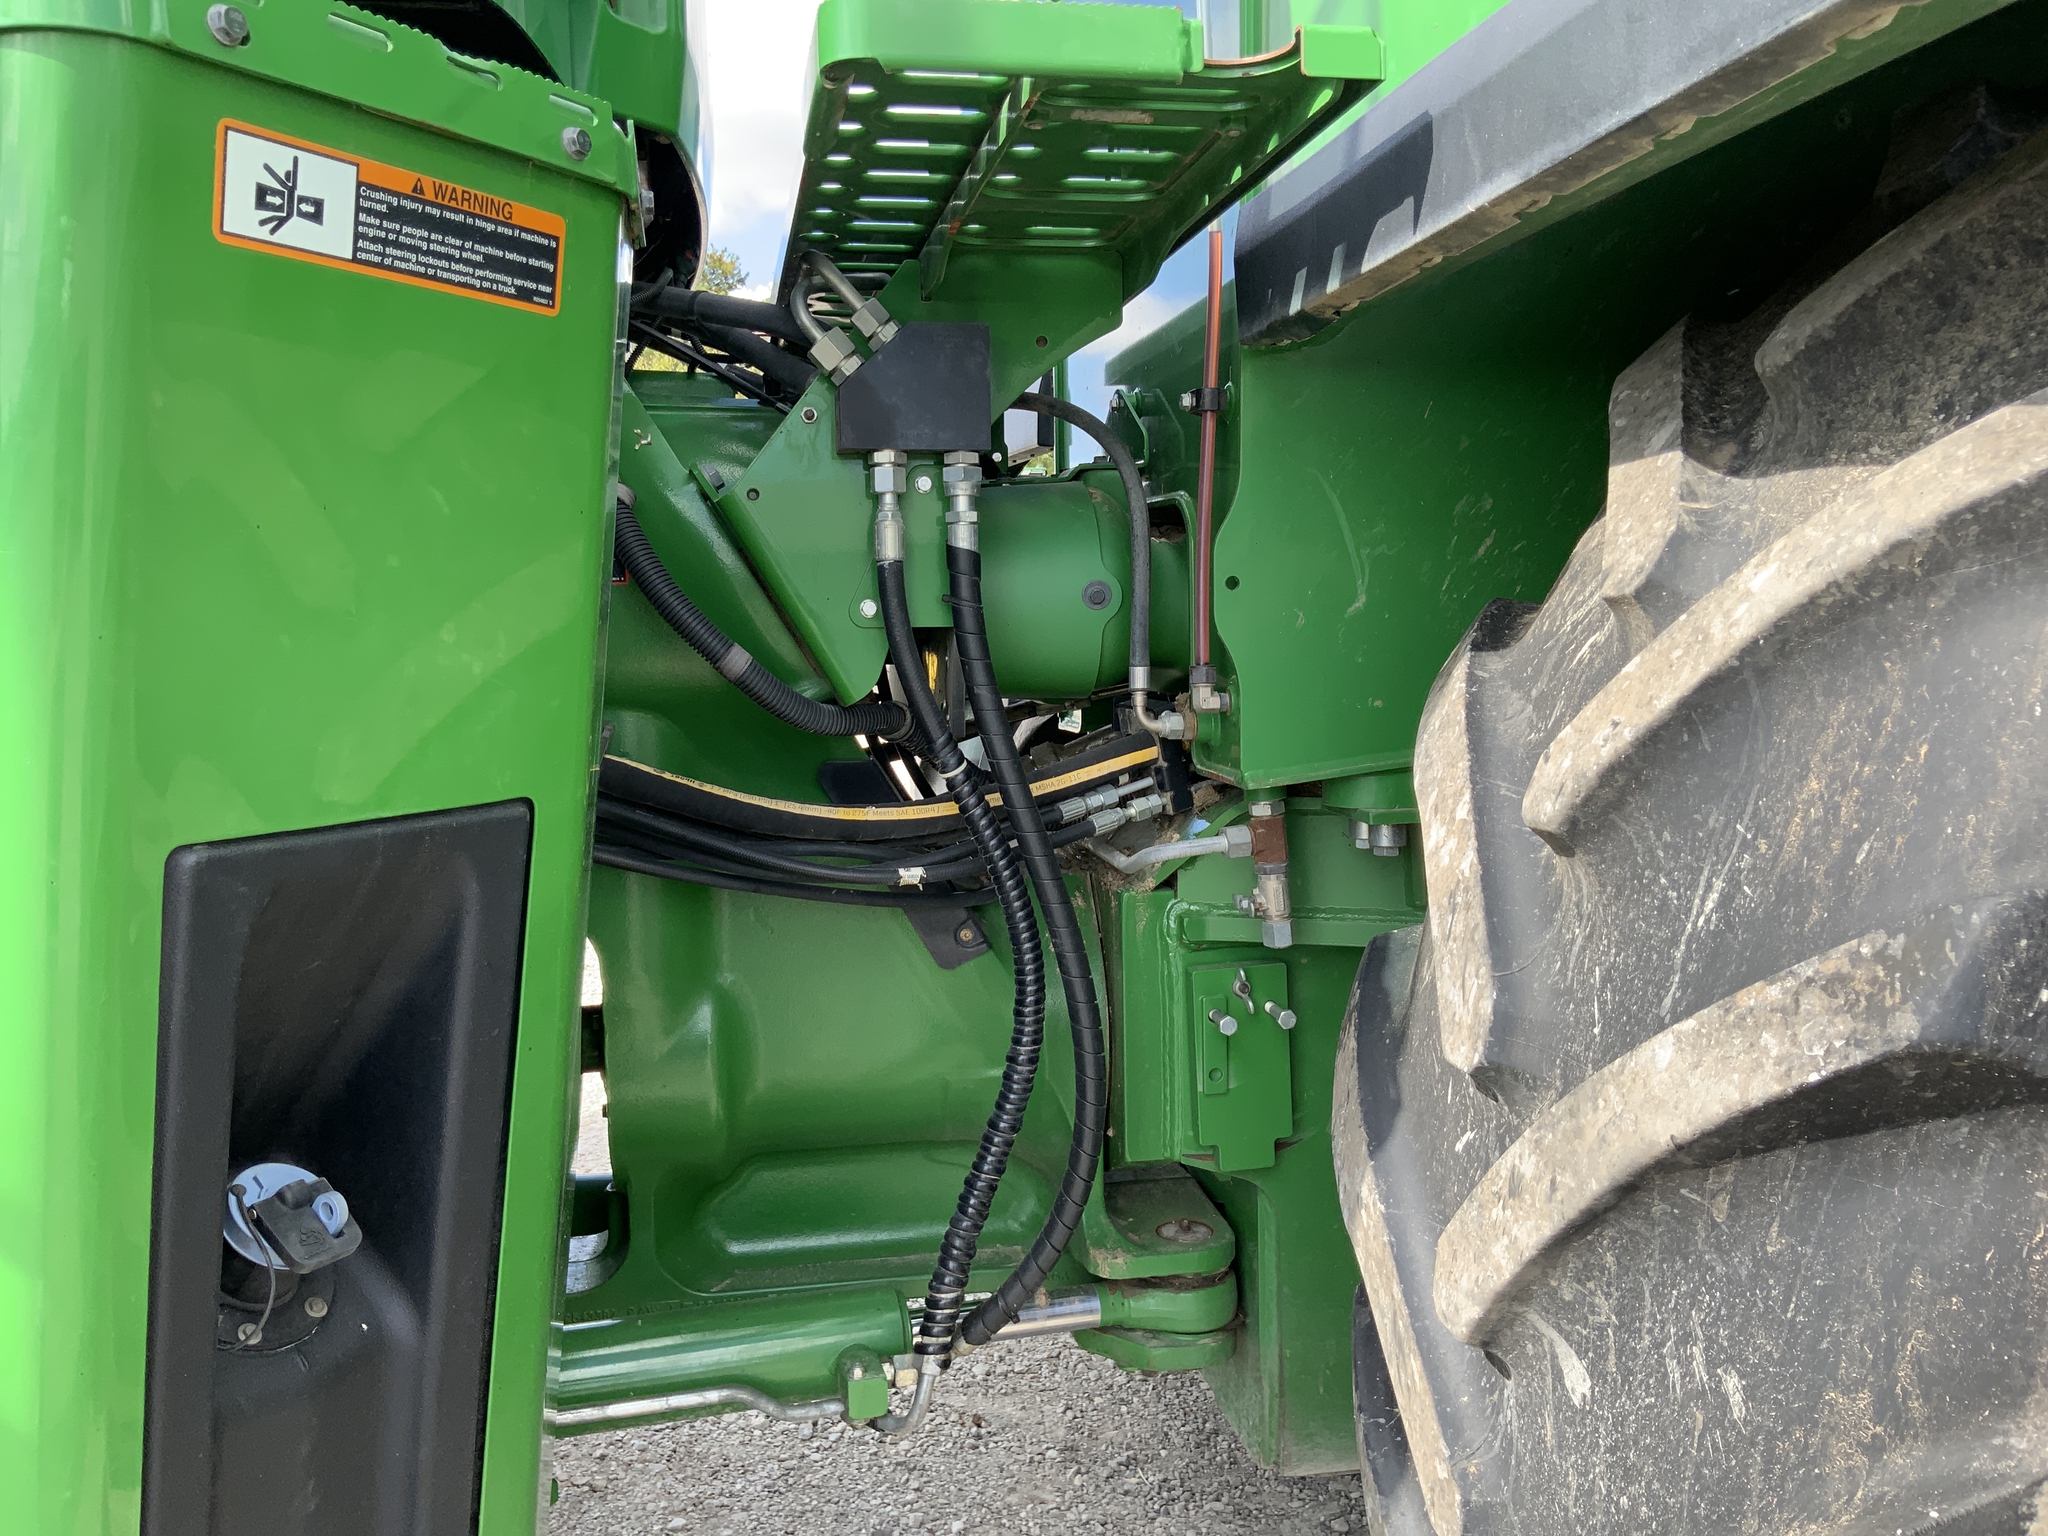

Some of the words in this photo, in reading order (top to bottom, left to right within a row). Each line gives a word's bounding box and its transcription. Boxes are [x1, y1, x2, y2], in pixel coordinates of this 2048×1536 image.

[360, 197, 389, 213] turned.
[360, 186, 398, 206] Crushing
[400, 197, 423, 212] injury
[425, 205, 441, 218] may
[443, 210, 465, 223] result
[466, 216, 474, 225] in
[475, 219, 496, 231] hinge
[497, 226, 513, 236] area
[514, 229, 520, 237] if
[521, 232, 549, 246] machine
[550, 239, 557, 248] is
[432, 180, 513, 222] WARNING
[358, 212, 381, 226] Make
[383, 220, 401, 231] sure
[402, 225, 429, 239] people
[431, 233, 443, 243] are
[444, 235, 463, 247] clear
[465, 241, 473, 249] of
[474, 243, 504, 257] machine
[505, 251, 527, 264] before
[528, 258, 554, 273] starting
[358, 225, 386, 238] engine
[388, 232, 397, 241] or
[398, 235, 428, 251] moving
[429, 242, 460, 259] steering
[462, 248, 485, 263] wheel.
[356, 251, 383, 263] center
[384, 256, 393, 266] of
[394, 259, 426, 274] machine
[437, 269, 481, 288] transporting
[482, 281, 492, 289] on
[498, 284, 518, 296] truck.
[357, 239, 384, 253] Attach
[385, 246, 417, 263] steering
[418, 253, 449, 269] lockouts
[451, 261, 474, 274] before
[475, 269, 512, 285] performing
[513, 278, 537, 290] service
[538, 284, 553, 294] near
[1035, 781, 1056, 792] MSHA
[1056, 773, 1082, 787] 2G-11C
[852, 809, 870, 817] 275F
[872, 808, 894, 817] Meets
[895, 808, 910, 816] SAE
[912, 805, 935, 816] 100R4
